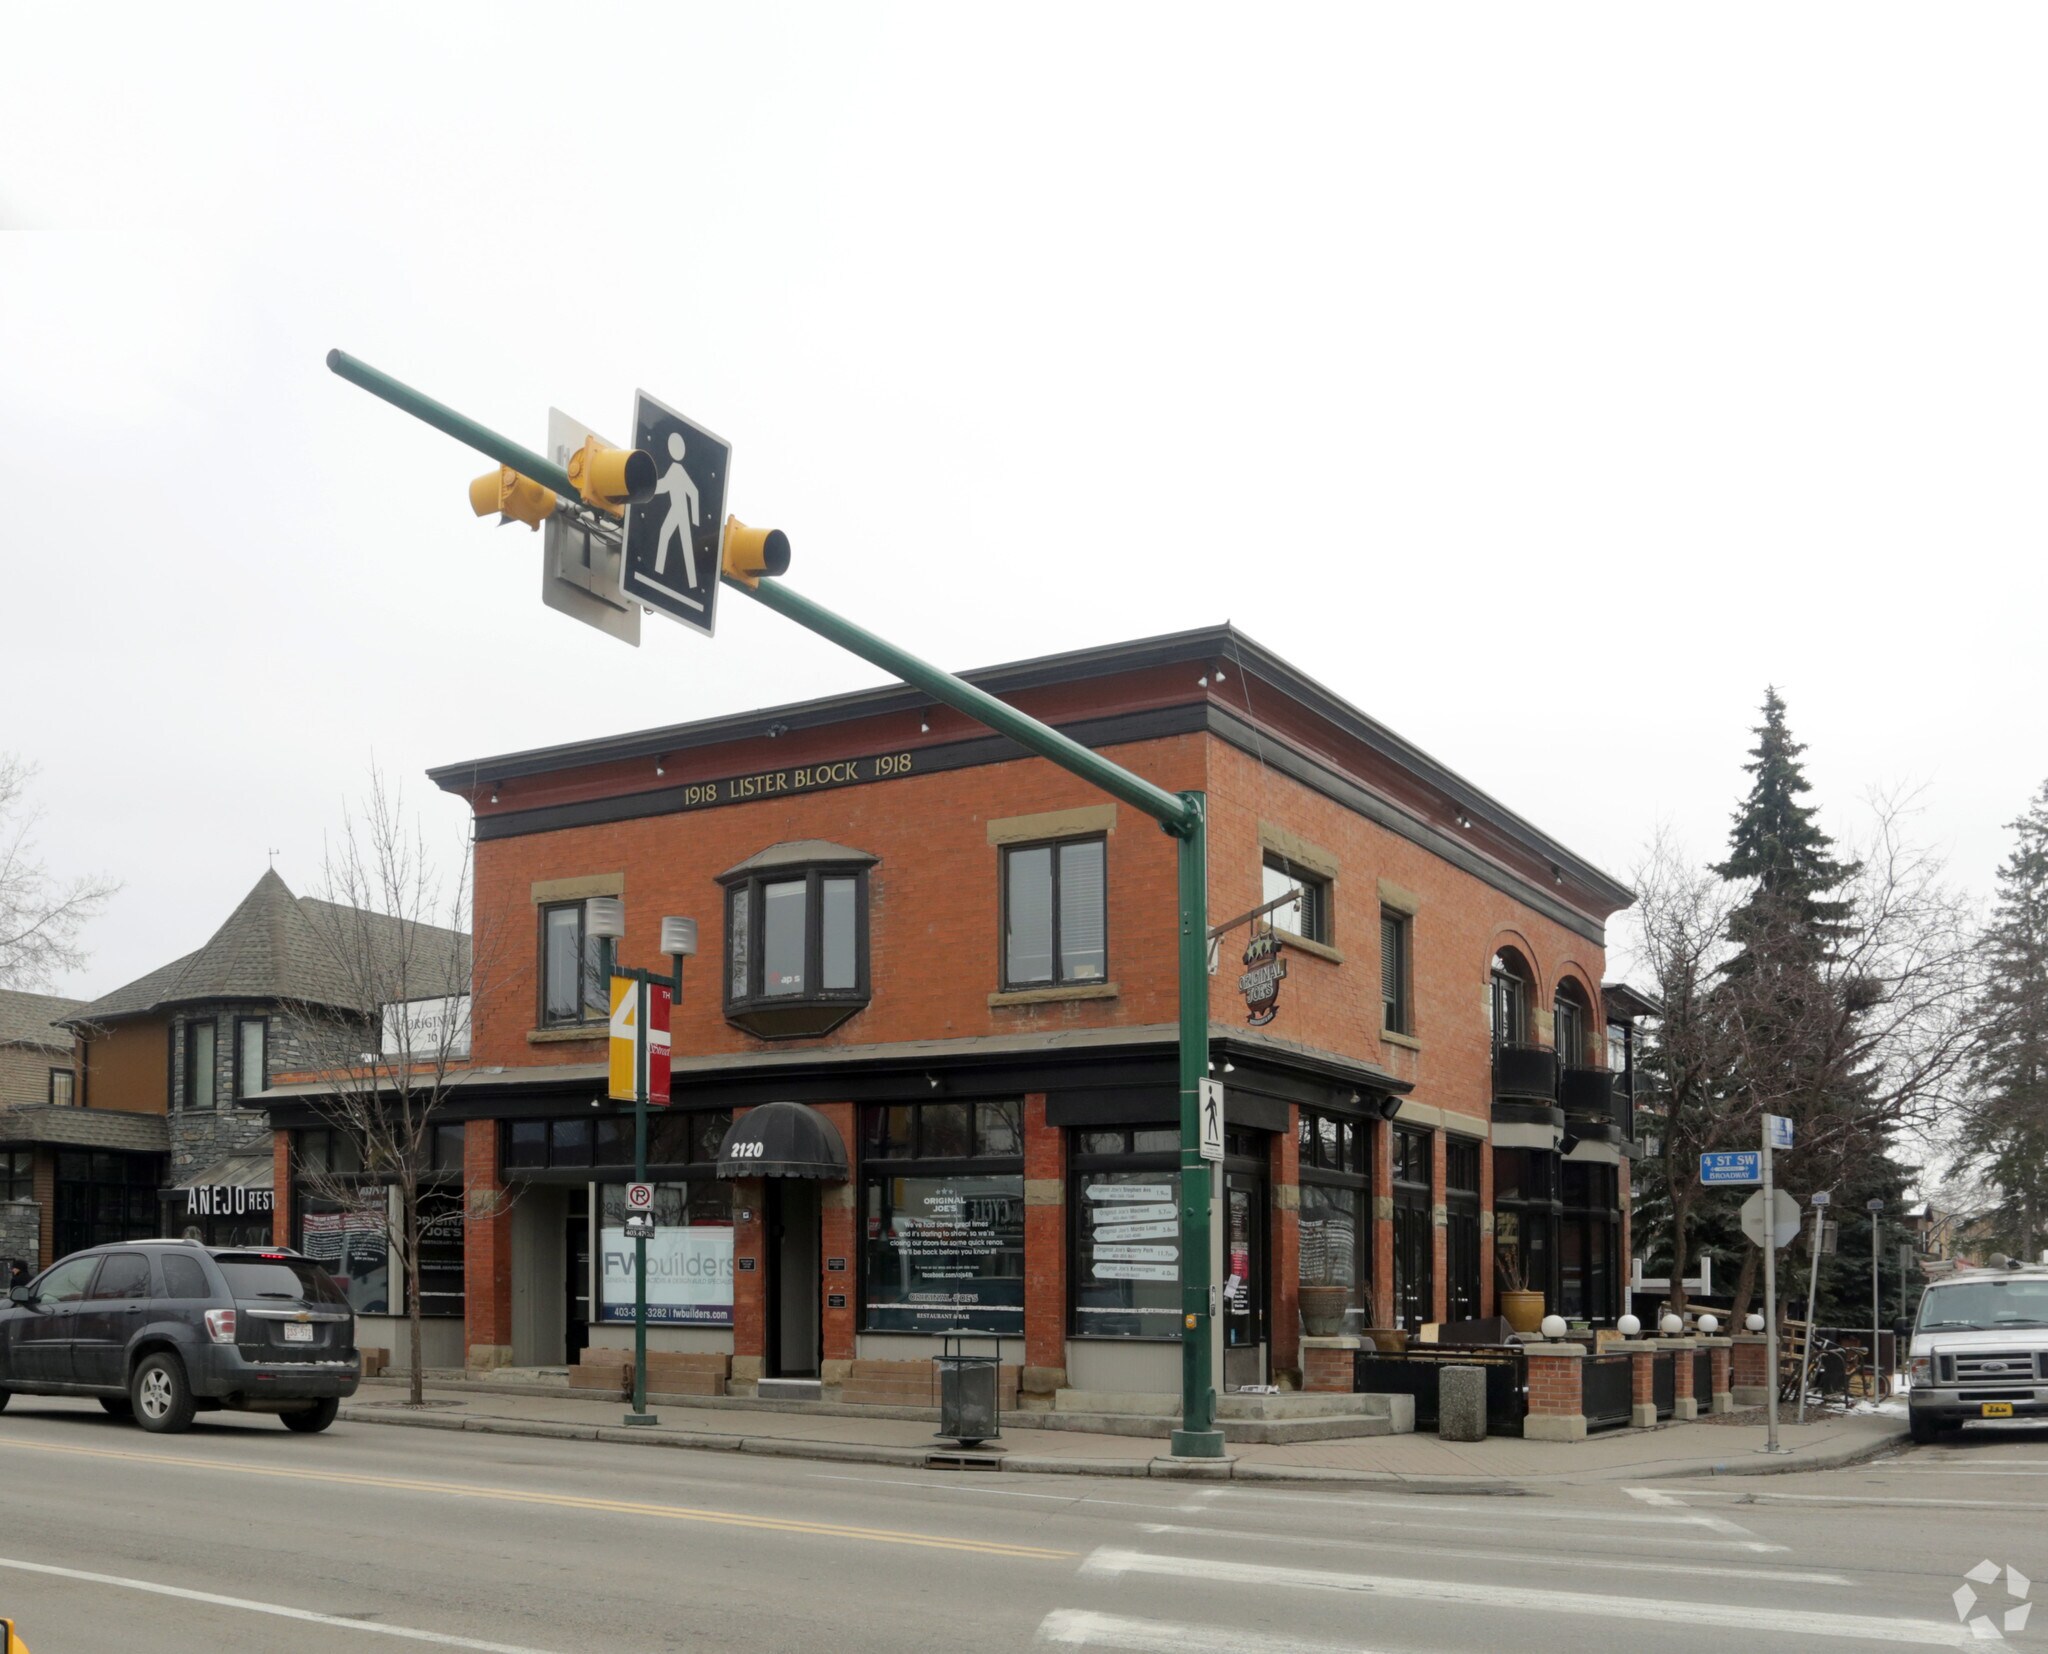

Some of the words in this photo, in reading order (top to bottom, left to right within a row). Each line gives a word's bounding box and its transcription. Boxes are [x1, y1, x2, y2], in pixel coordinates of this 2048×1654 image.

[684, 783, 718, 806] 1918
[730, 772, 788, 799] LISTER
[794, 761, 859, 789] BLOCK
[875, 753, 912, 776] 1918
[1239, 962, 1285, 991] ORIGINAL
[662, 990, 671, 1000] TH
[1247, 982, 1273, 1004] JOE'S
[407, 1013, 457, 1031] ORIGINL
[730, 1142, 764, 1158] 2120
[1704, 1156, 1712, 1167] 4
[1717, 1155, 1733, 1166] ST
[1737, 1154, 1756, 1165] SW
[1709, 1171, 1750, 1180] BROADWAY
[187, 1184, 245, 1215] AÑEJO
[248, 1191, 275, 1210] REST
[908, 1293, 950, 1302] ORIGINAL
[614, 1307, 666, 1318] 403-8-3282
[673, 1309, 728, 1319] fwbuilders.com
[916, 1312, 952, 1320] RESTAURANT
